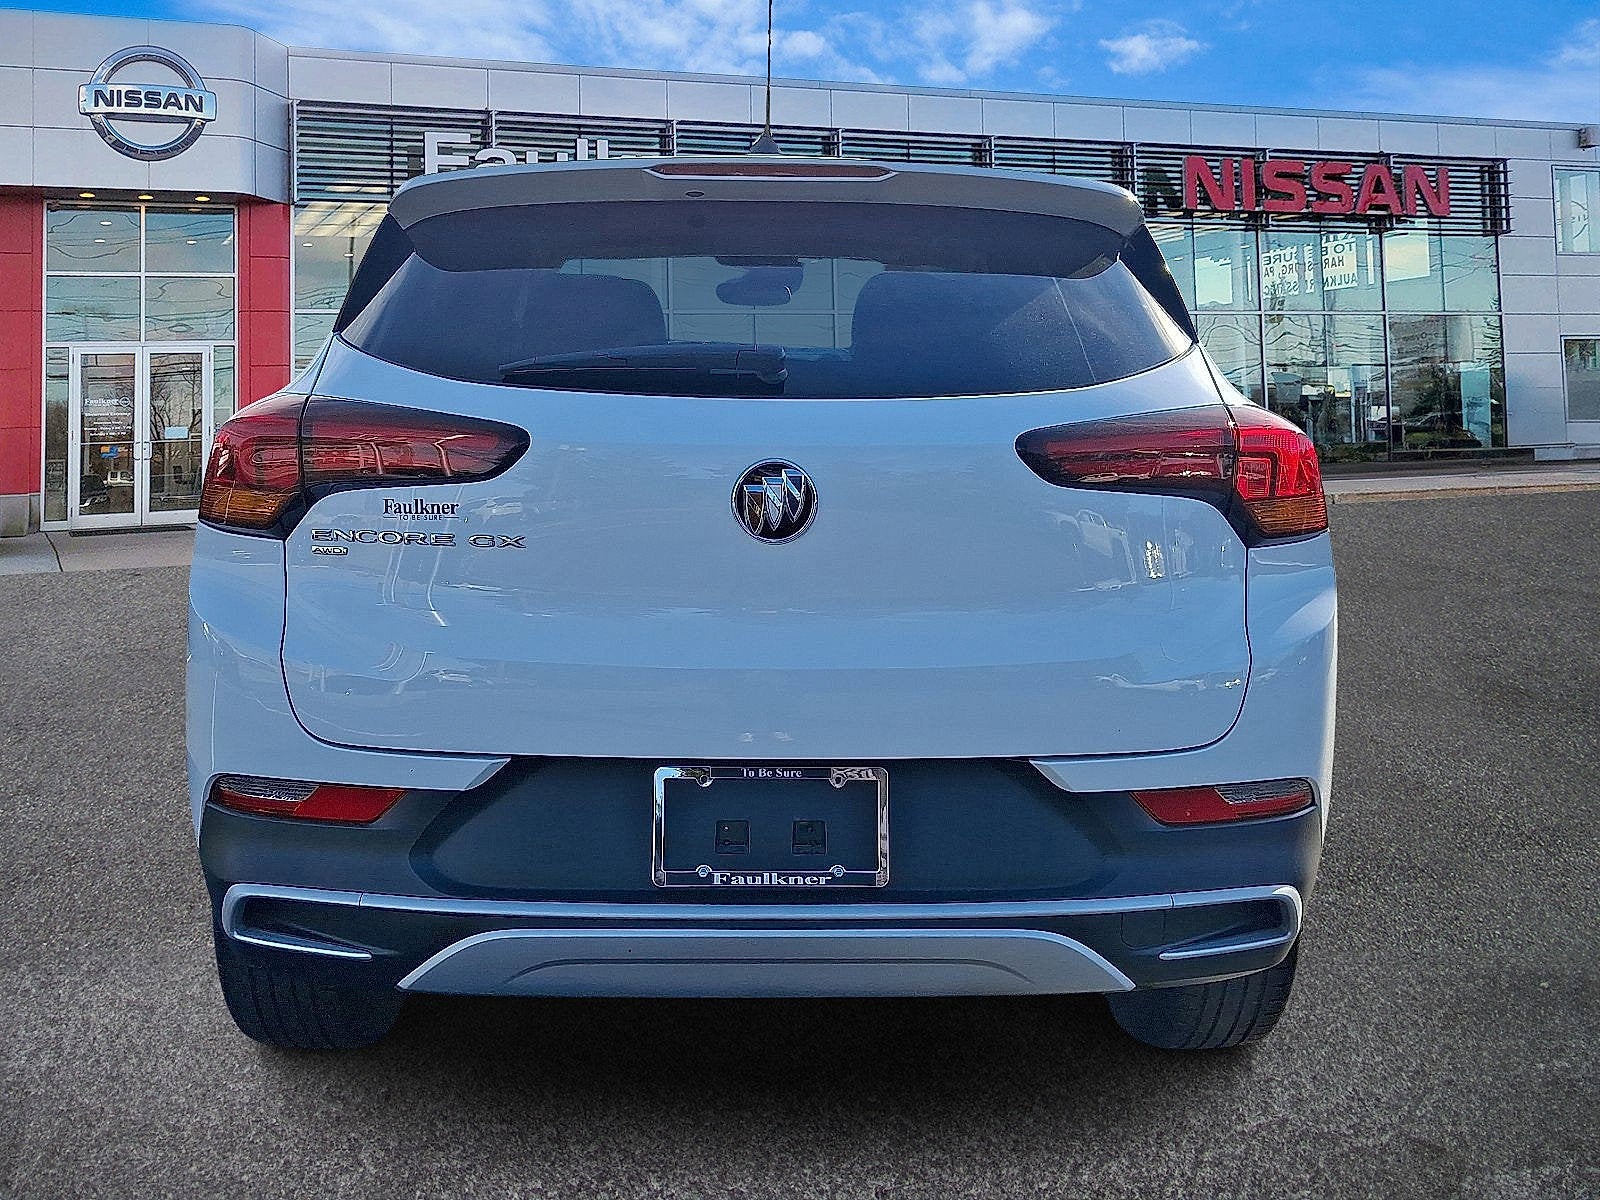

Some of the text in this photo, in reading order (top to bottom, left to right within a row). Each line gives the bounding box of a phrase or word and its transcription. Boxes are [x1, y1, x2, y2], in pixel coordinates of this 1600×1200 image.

[94, 89, 204, 113] NISSAN
[1183, 155, 1451, 216] NISSAN
[383, 498, 460, 515] Faulkner
[311, 528, 527, 549] ENCORE GX
[740, 768, 803, 778] To Be Sure
[712, 872, 833, 886] Faulkner
